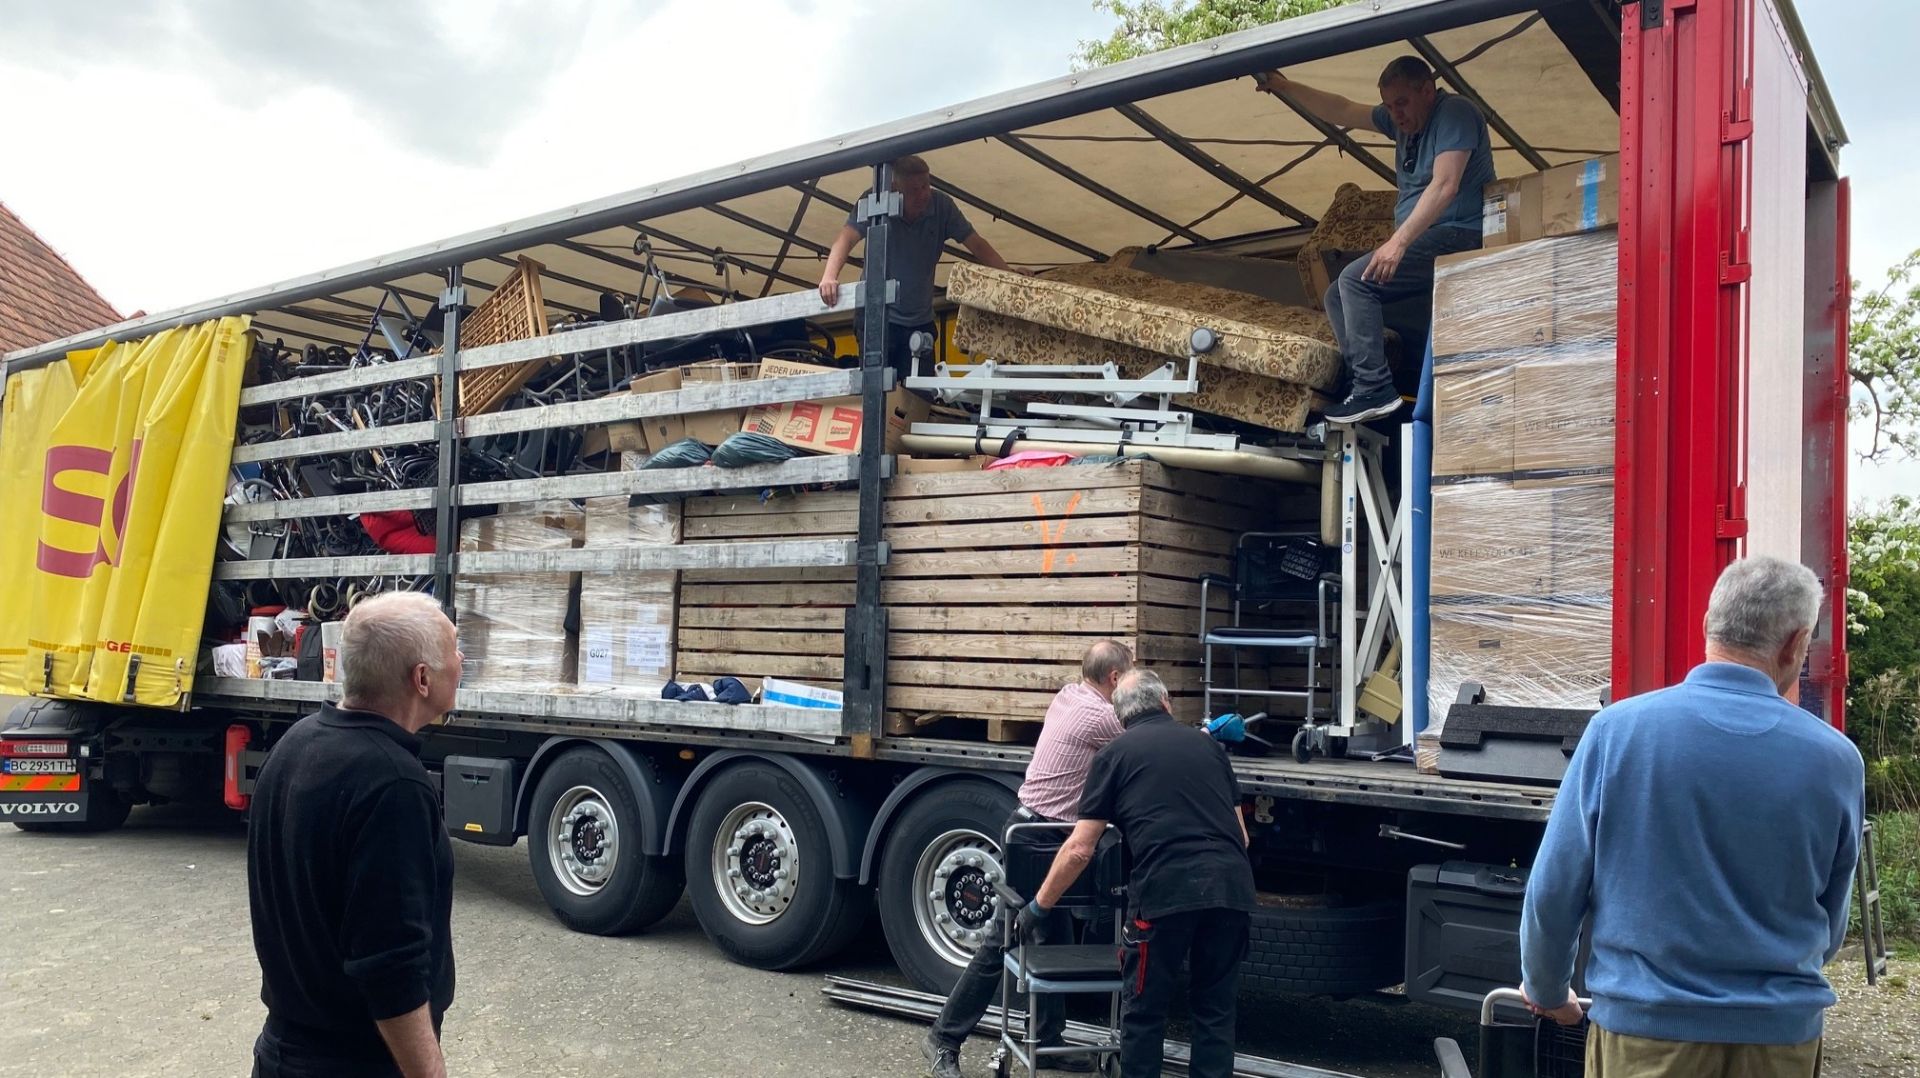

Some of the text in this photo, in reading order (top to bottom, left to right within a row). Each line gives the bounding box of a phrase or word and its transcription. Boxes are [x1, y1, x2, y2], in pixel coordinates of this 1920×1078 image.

[765, 365, 789, 375] JEDER
[589, 648, 609, 658] G027
[11, 761, 28, 771] BC
[29, 761, 56, 771] 2951
[0, 802, 80, 815] VOLVO
